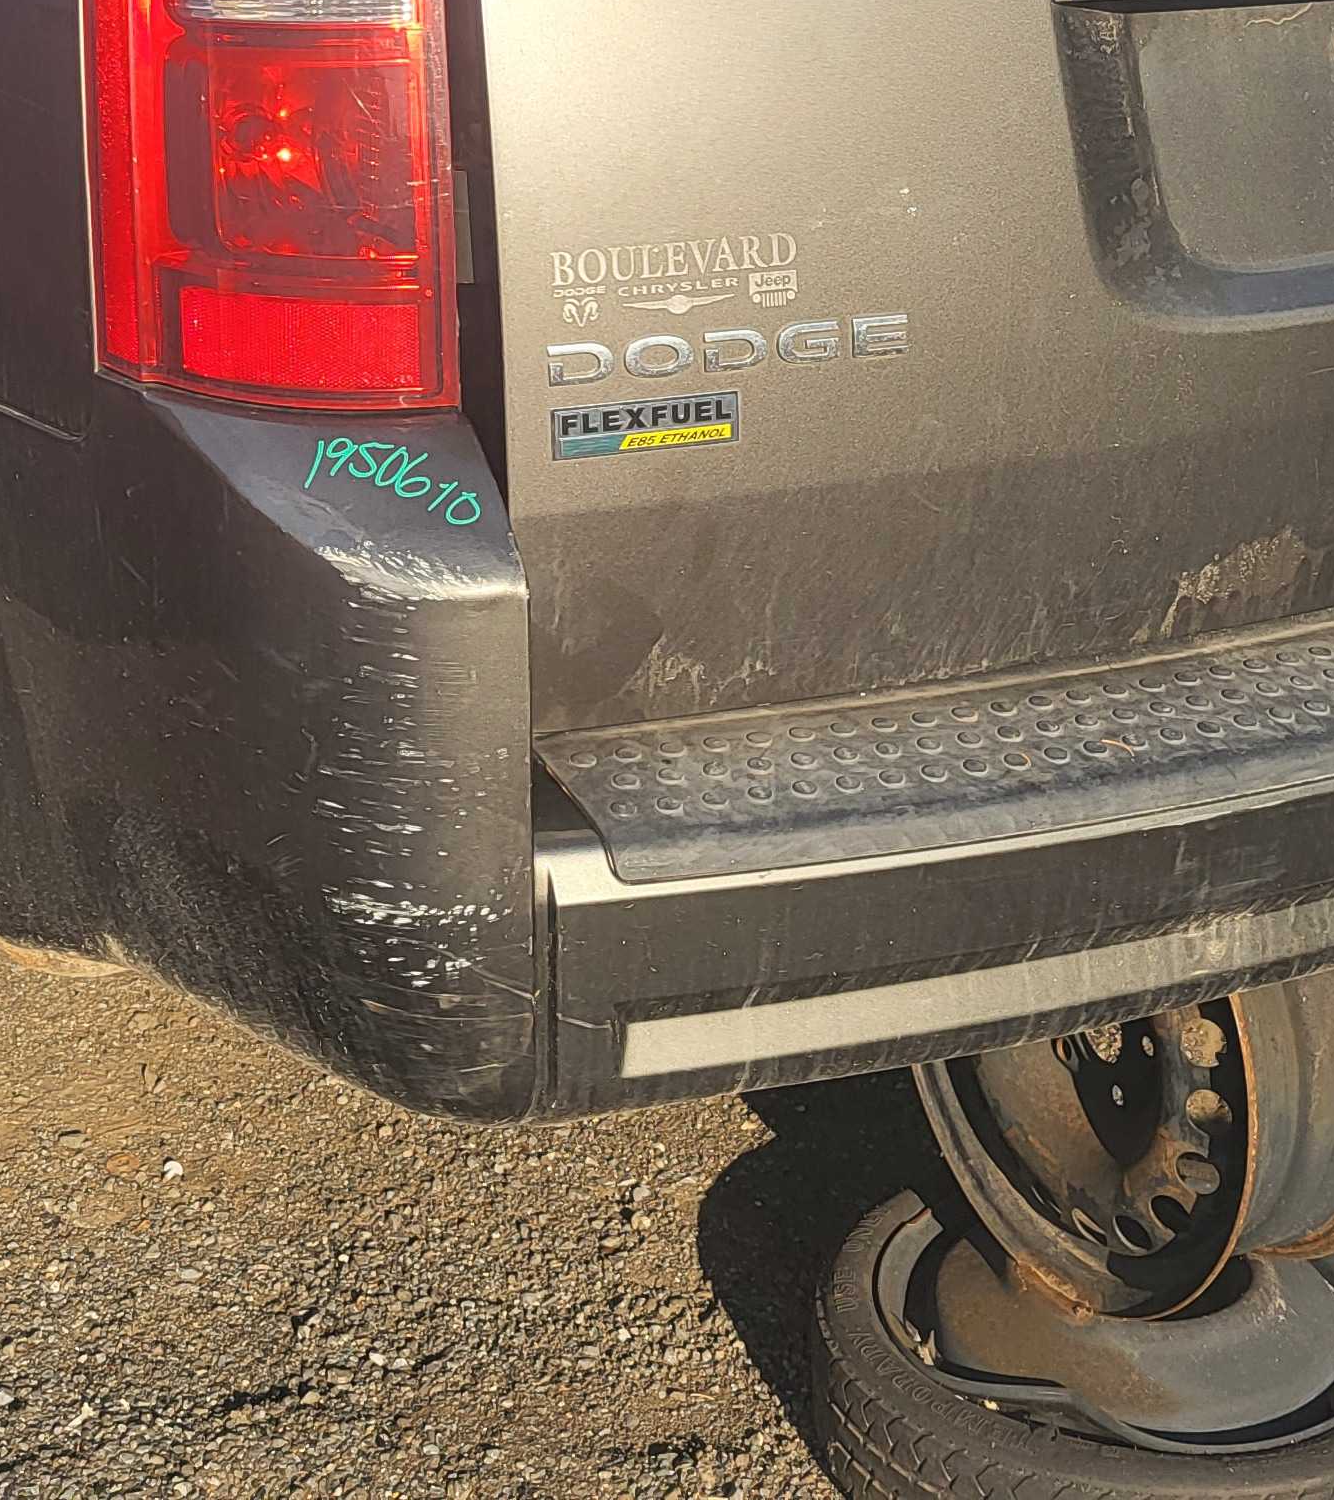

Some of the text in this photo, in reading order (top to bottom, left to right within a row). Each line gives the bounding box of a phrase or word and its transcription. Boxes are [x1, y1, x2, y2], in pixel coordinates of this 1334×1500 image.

[550, 232, 797, 287] BOULEVARD
[553, 273, 791, 298] DODGE CHRYSLER Jeep
[546, 313, 908, 388] DODGE
[561, 399, 732, 436] FLEXFUEL
[627, 428, 727, 448] E85 ETHANOL
[834, 1266, 857, 1313] USE
